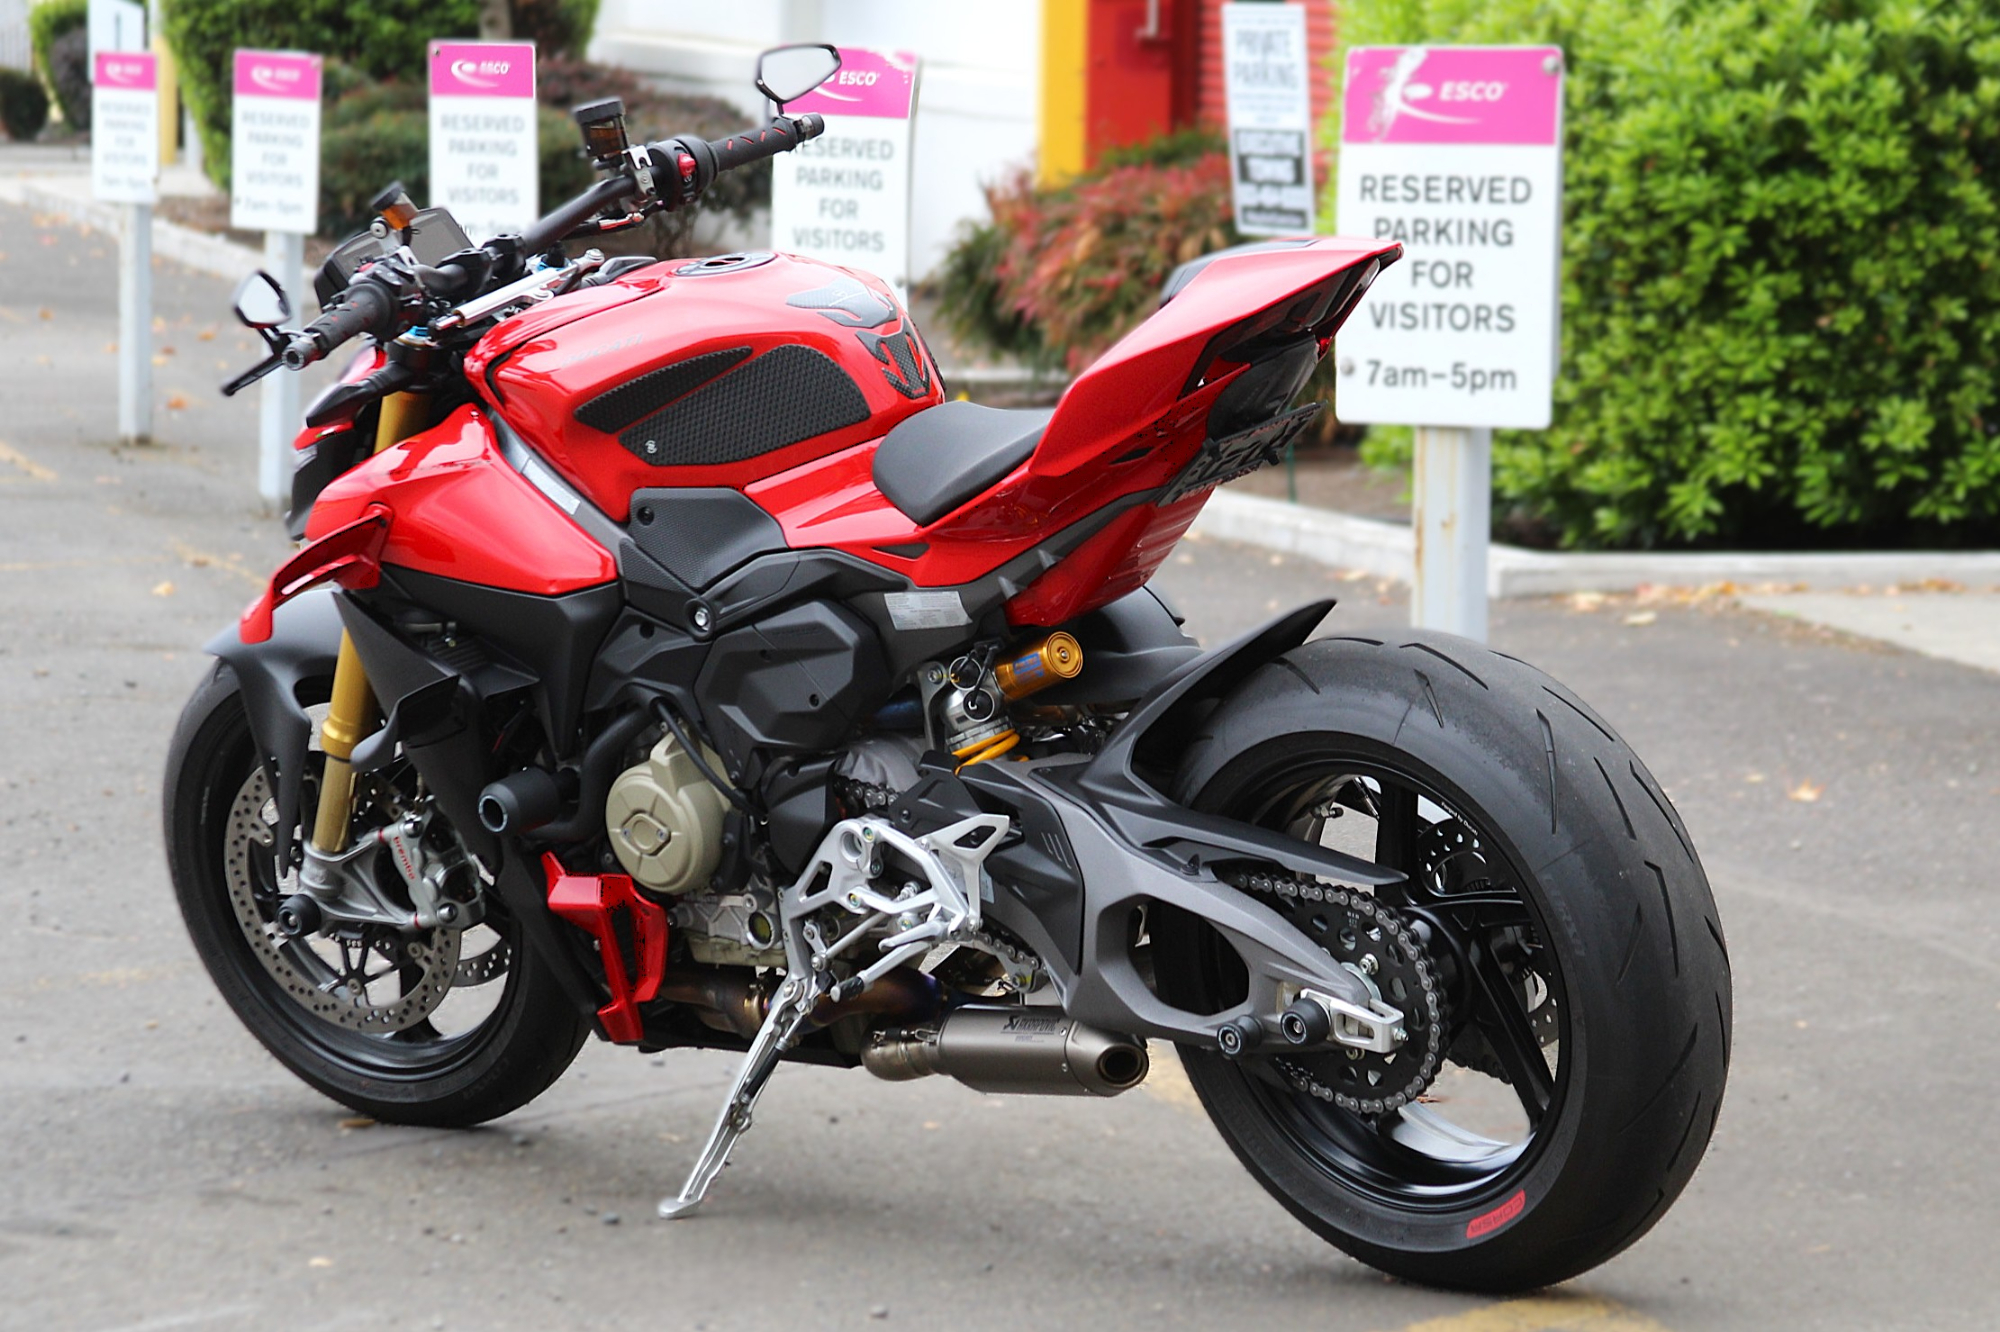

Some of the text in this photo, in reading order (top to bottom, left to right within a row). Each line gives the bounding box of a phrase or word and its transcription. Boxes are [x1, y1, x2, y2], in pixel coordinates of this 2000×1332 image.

[839, 71, 877, 86] ESCO
[1439, 80, 1504, 101] ESCO
[440, 114, 525, 133] RESERVED
[448, 139, 517, 156] PARKING
[791, 137, 895, 161] ESERVED
[467, 163, 498, 179] FOR
[796, 166, 883, 191] PARKING
[448, 186, 520, 205] VISITORS
[1359, 174, 1532, 204] RESERVED
[819, 198, 858, 220] FOR
[793, 227, 885, 252] VISITORS
[1374, 216, 1514, 247] PARKING
[1411, 260, 1474, 289] FOR
[1369, 302, 1516, 333] VISITORS
[393, 835, 416, 880] brembo
